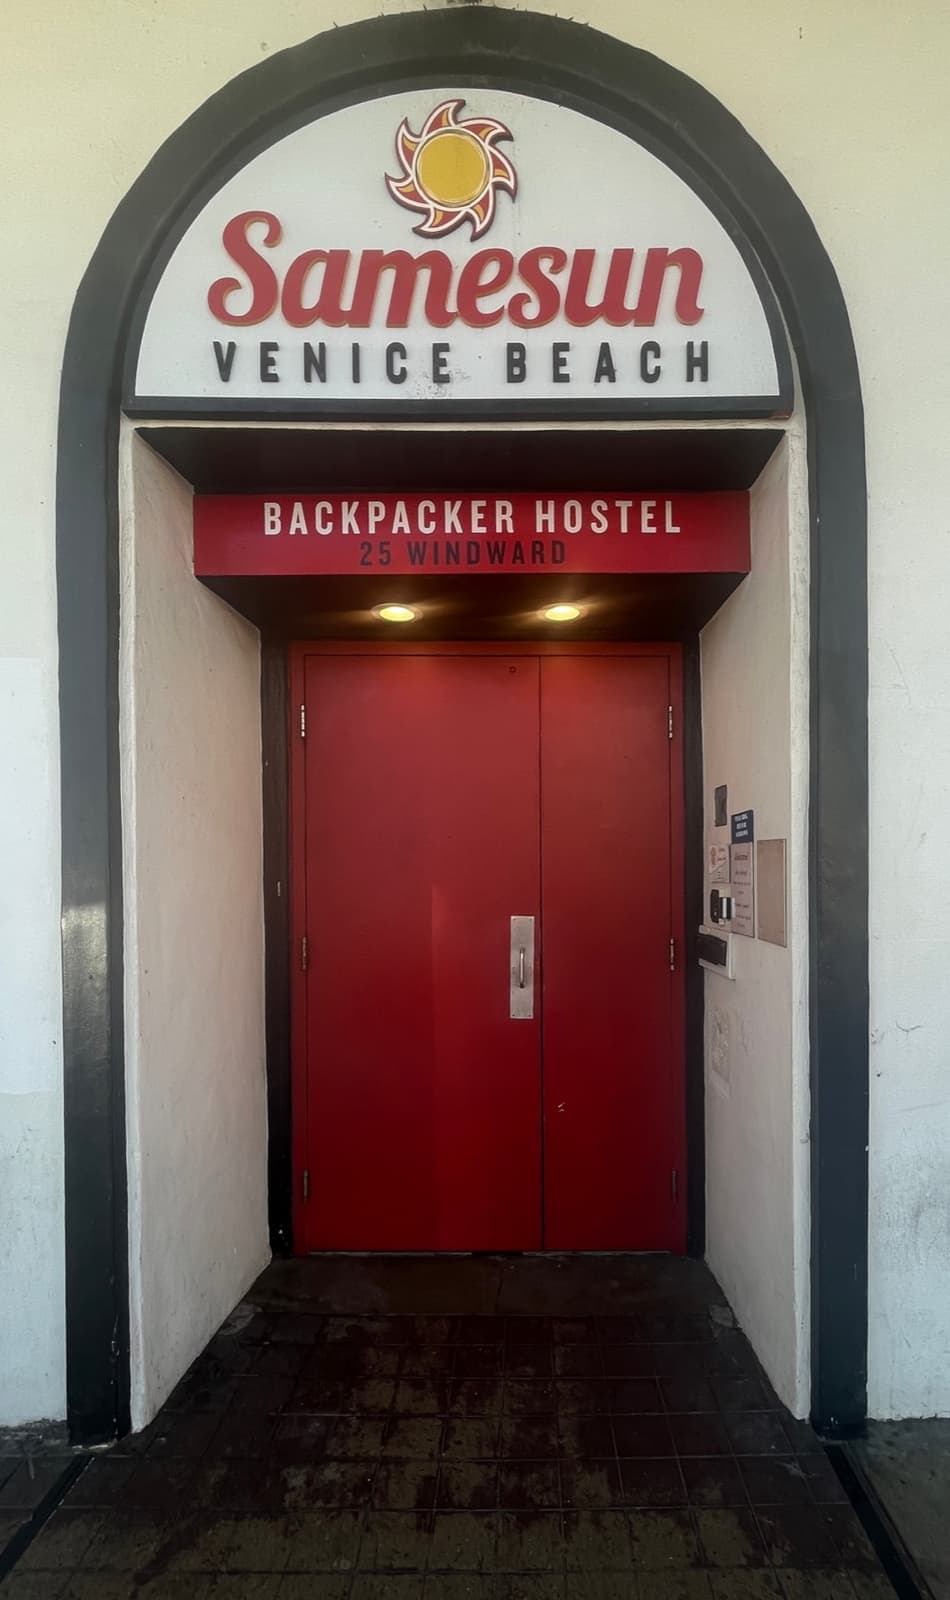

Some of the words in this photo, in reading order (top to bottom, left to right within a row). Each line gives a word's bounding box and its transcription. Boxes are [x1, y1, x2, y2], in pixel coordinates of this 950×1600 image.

[207, 210, 704, 329] Samesun
[213, 341, 451, 384] VENICE
[506, 340, 709, 384] BEACH
[263, 501, 516, 536] BACKPACKER
[535, 498, 681, 534] HOSTEL
[359, 541, 392, 567] 25
[407, 540, 566, 566] WINDWARD
